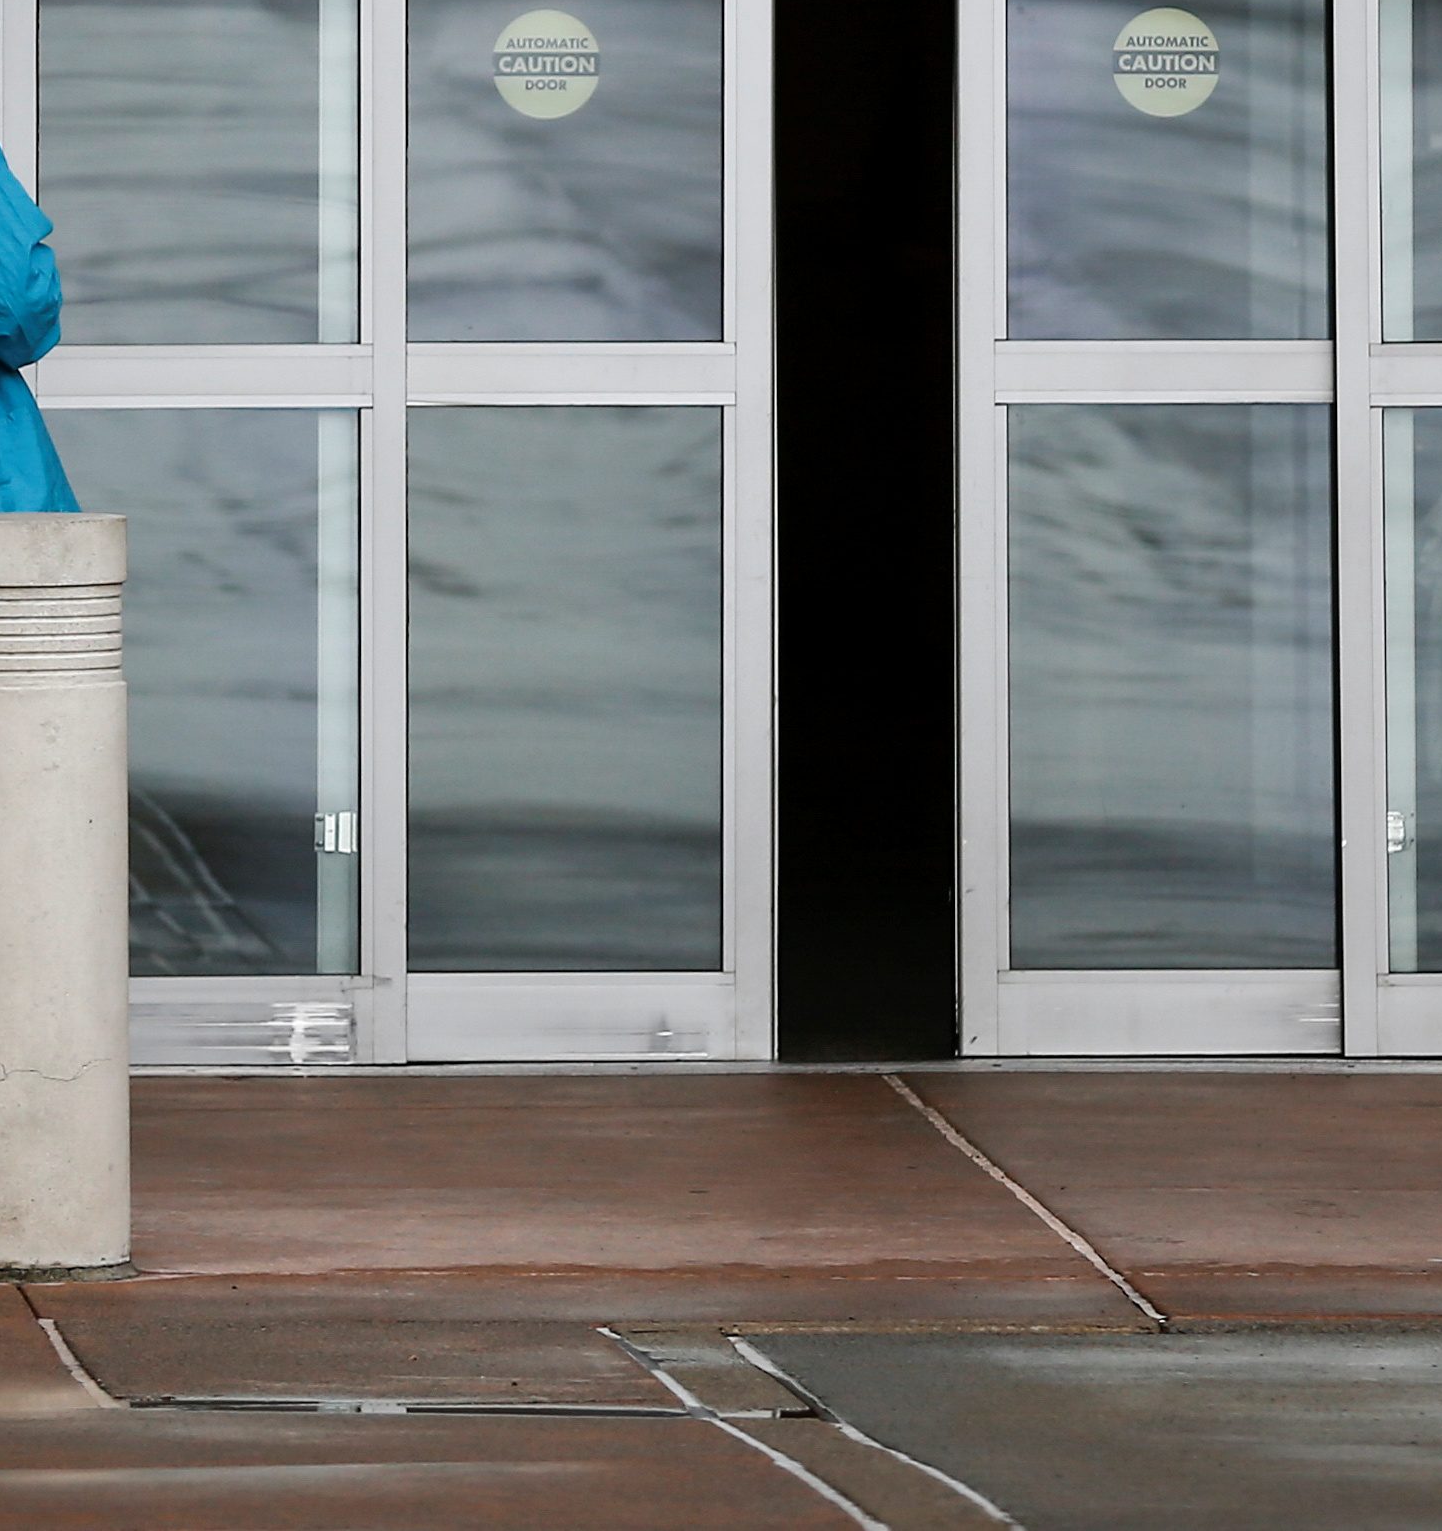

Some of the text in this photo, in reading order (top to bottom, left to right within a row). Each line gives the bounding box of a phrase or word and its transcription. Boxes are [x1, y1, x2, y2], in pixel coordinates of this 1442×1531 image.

[506, 37, 589, 49] AUTOMATIC
[1126, 36, 1209, 47] AUTOMATIC
[498, 56, 595, 73] CAUTION
[1118, 54, 1215, 72] CAUTION
[525, 79, 567, 90] DOOR
[1145, 77, 1187, 89] DOOR
